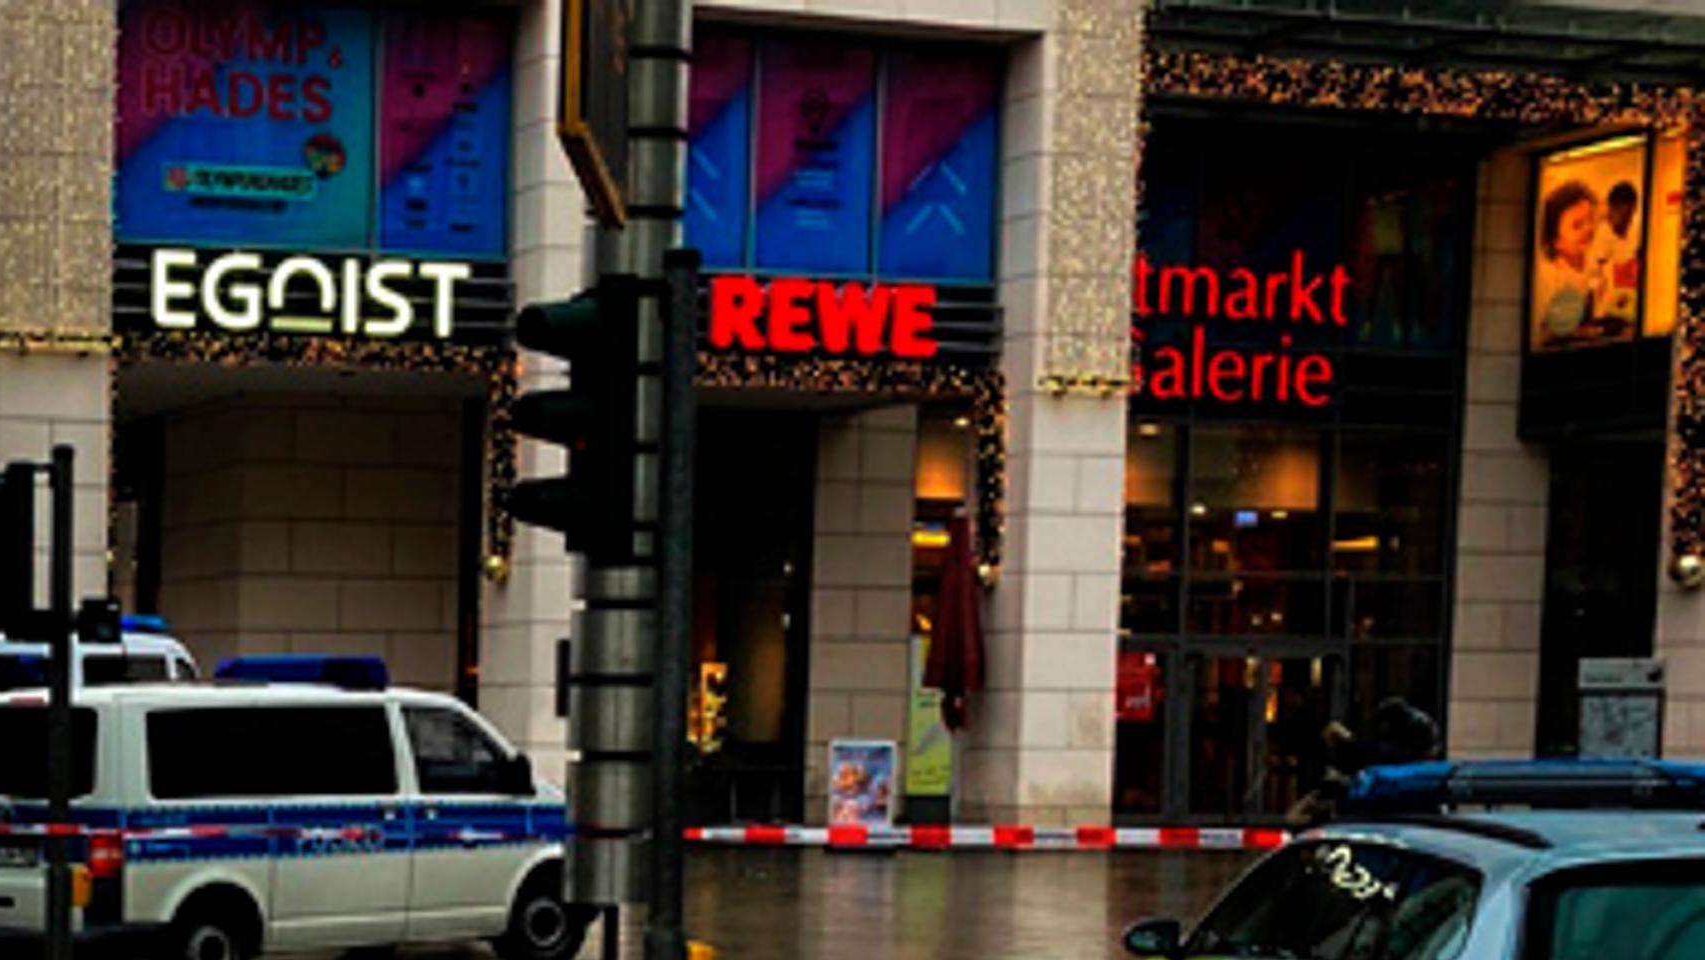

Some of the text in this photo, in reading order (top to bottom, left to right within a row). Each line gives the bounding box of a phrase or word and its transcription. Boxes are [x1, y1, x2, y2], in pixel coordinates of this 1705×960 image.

[144, 9, 324, 66] OLYMP
[143, 62, 333, 123] HADES
[151, 249, 472, 338] EGOIST
[710, 275, 939, 358] REWE
